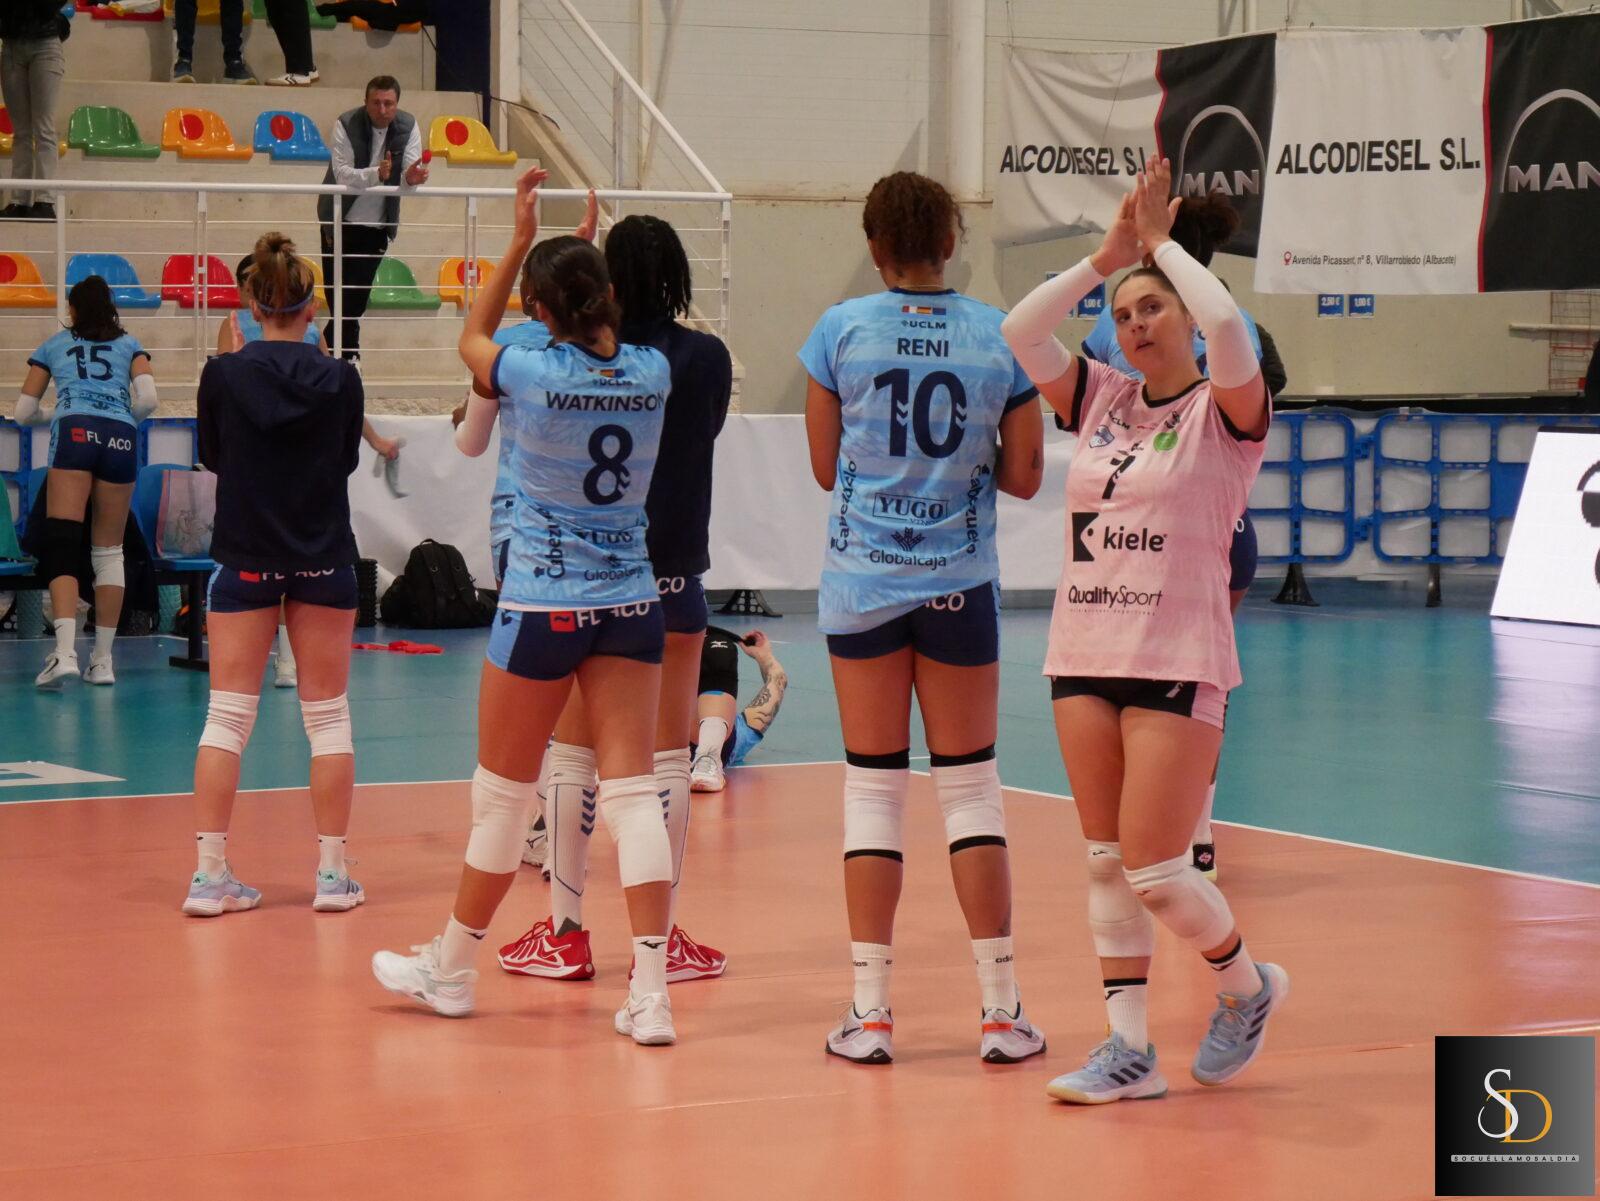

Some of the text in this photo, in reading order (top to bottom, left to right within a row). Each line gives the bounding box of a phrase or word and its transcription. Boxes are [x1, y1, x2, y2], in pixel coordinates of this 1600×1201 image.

[1000, 145, 1120, 176] ALCODIESEL
[1275, 137, 1481, 175] ALCODIESEL S.L.
[1182, 169, 1260, 197] MAN
[1508, 161, 1600, 193] MAN
[1292, 255, 1322, 265] Avenida
[1375, 255, 1421, 265] Villarrobledo
[909, 320, 946, 330] UCLM
[897, 337, 949, 358] RENI
[66, 345, 114, 381] 15
[546, 390, 665, 412] WATKINSON
[873, 368, 967, 459] 10
[583, 424, 633, 505] 8
[1102, 455, 1136, 500] 7
[879, 496, 944, 519] YUGO
[1103, 525, 1165, 552] kiele
[869, 550, 947, 571] Globalcaja
